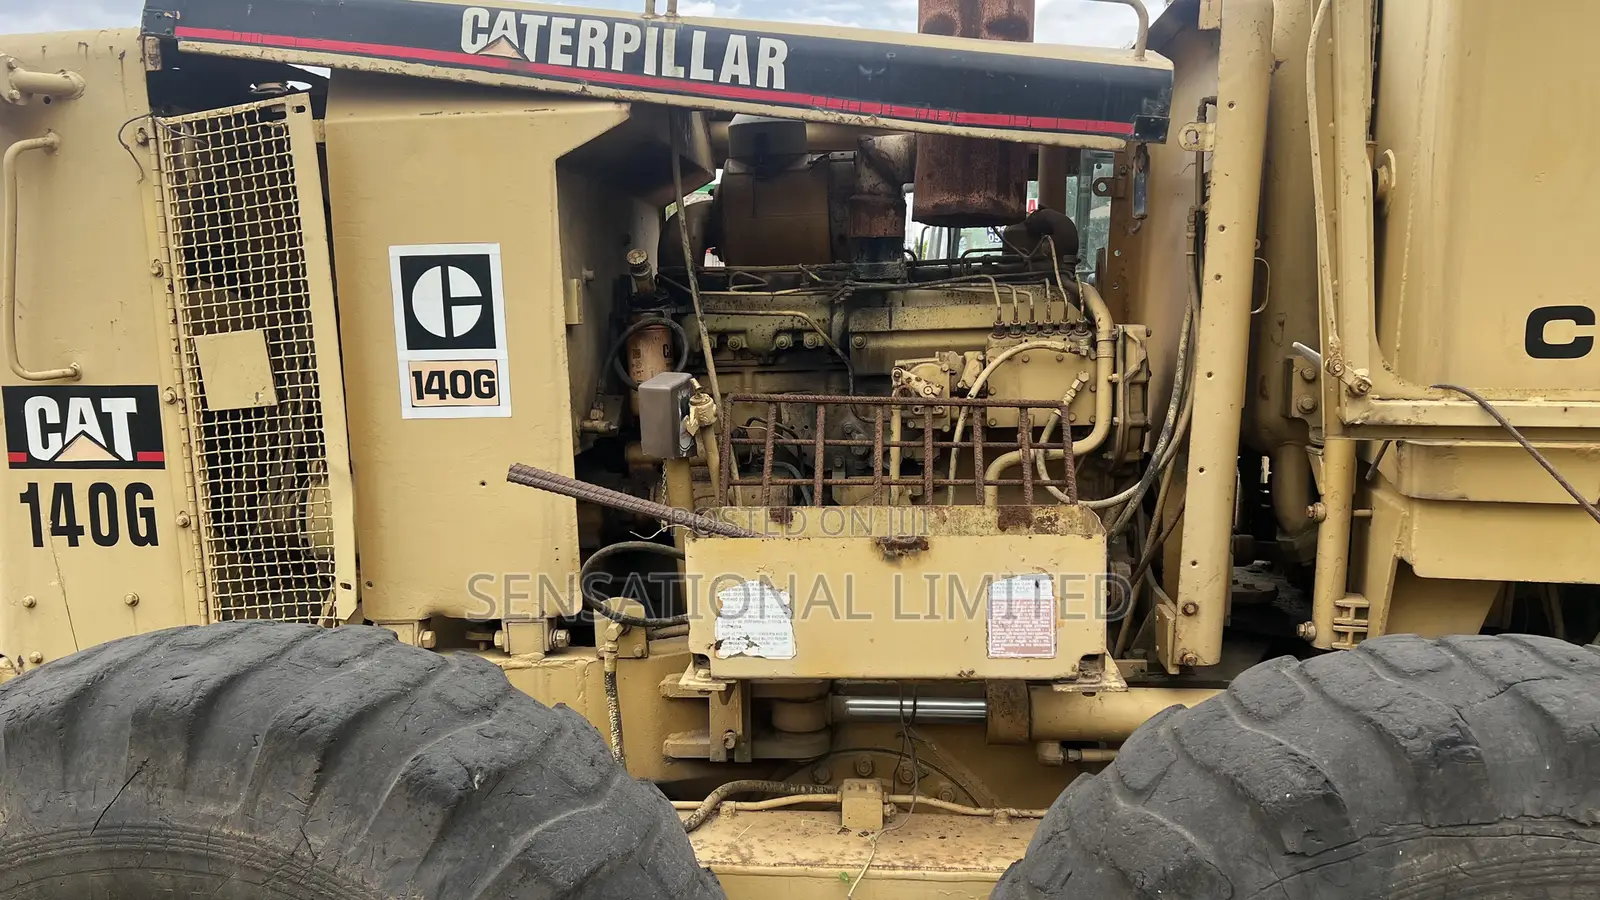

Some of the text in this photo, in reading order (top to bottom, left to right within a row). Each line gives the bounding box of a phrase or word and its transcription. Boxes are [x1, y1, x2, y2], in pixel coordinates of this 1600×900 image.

[461, 7, 788, 90] CATERPILLAR
[1525, 305, 1596, 359] C
[412, 369, 496, 400] 140G
[24, 396, 138, 462] CAT
[20, 482, 159, 548] 140G
